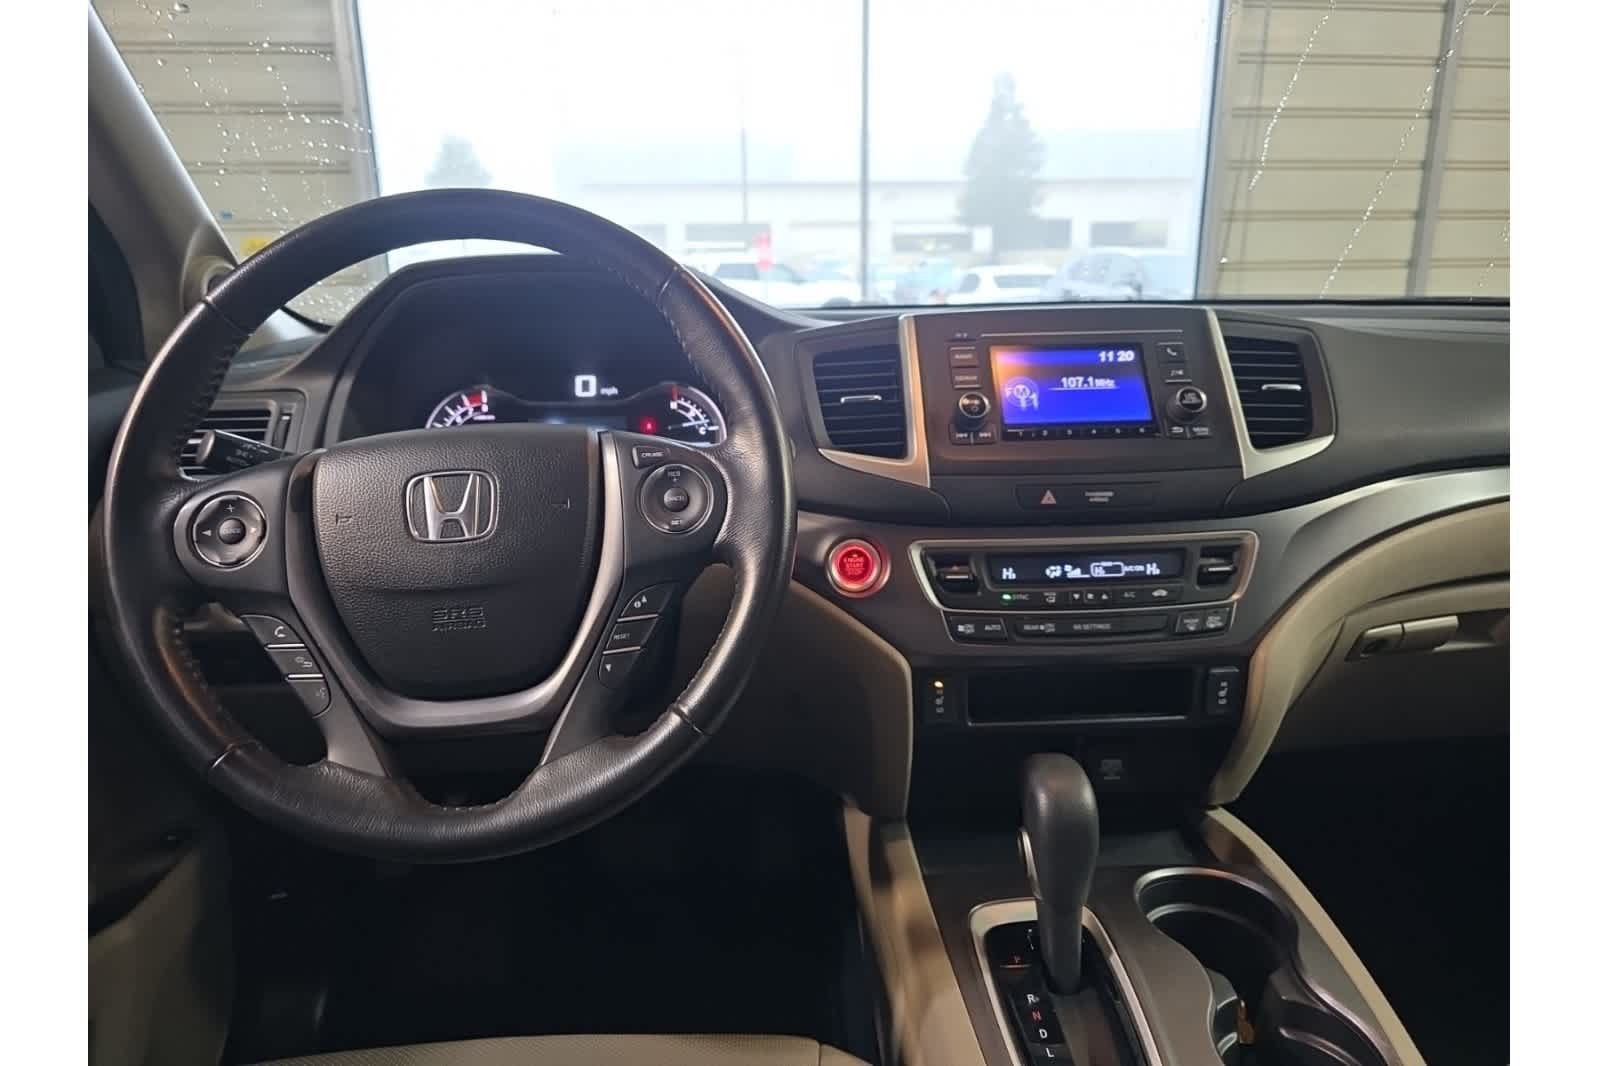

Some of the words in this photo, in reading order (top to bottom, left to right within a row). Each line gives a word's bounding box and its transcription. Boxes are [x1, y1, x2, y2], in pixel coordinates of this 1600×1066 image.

[574, 375, 597, 397] 0
[600, 386, 618, 396] mph
[1026, 994, 1036, 1005] R
[1032, 1010, 1043, 1021] N
[1039, 1028, 1049, 1039] D
[1046, 1047, 1056, 1058] L
